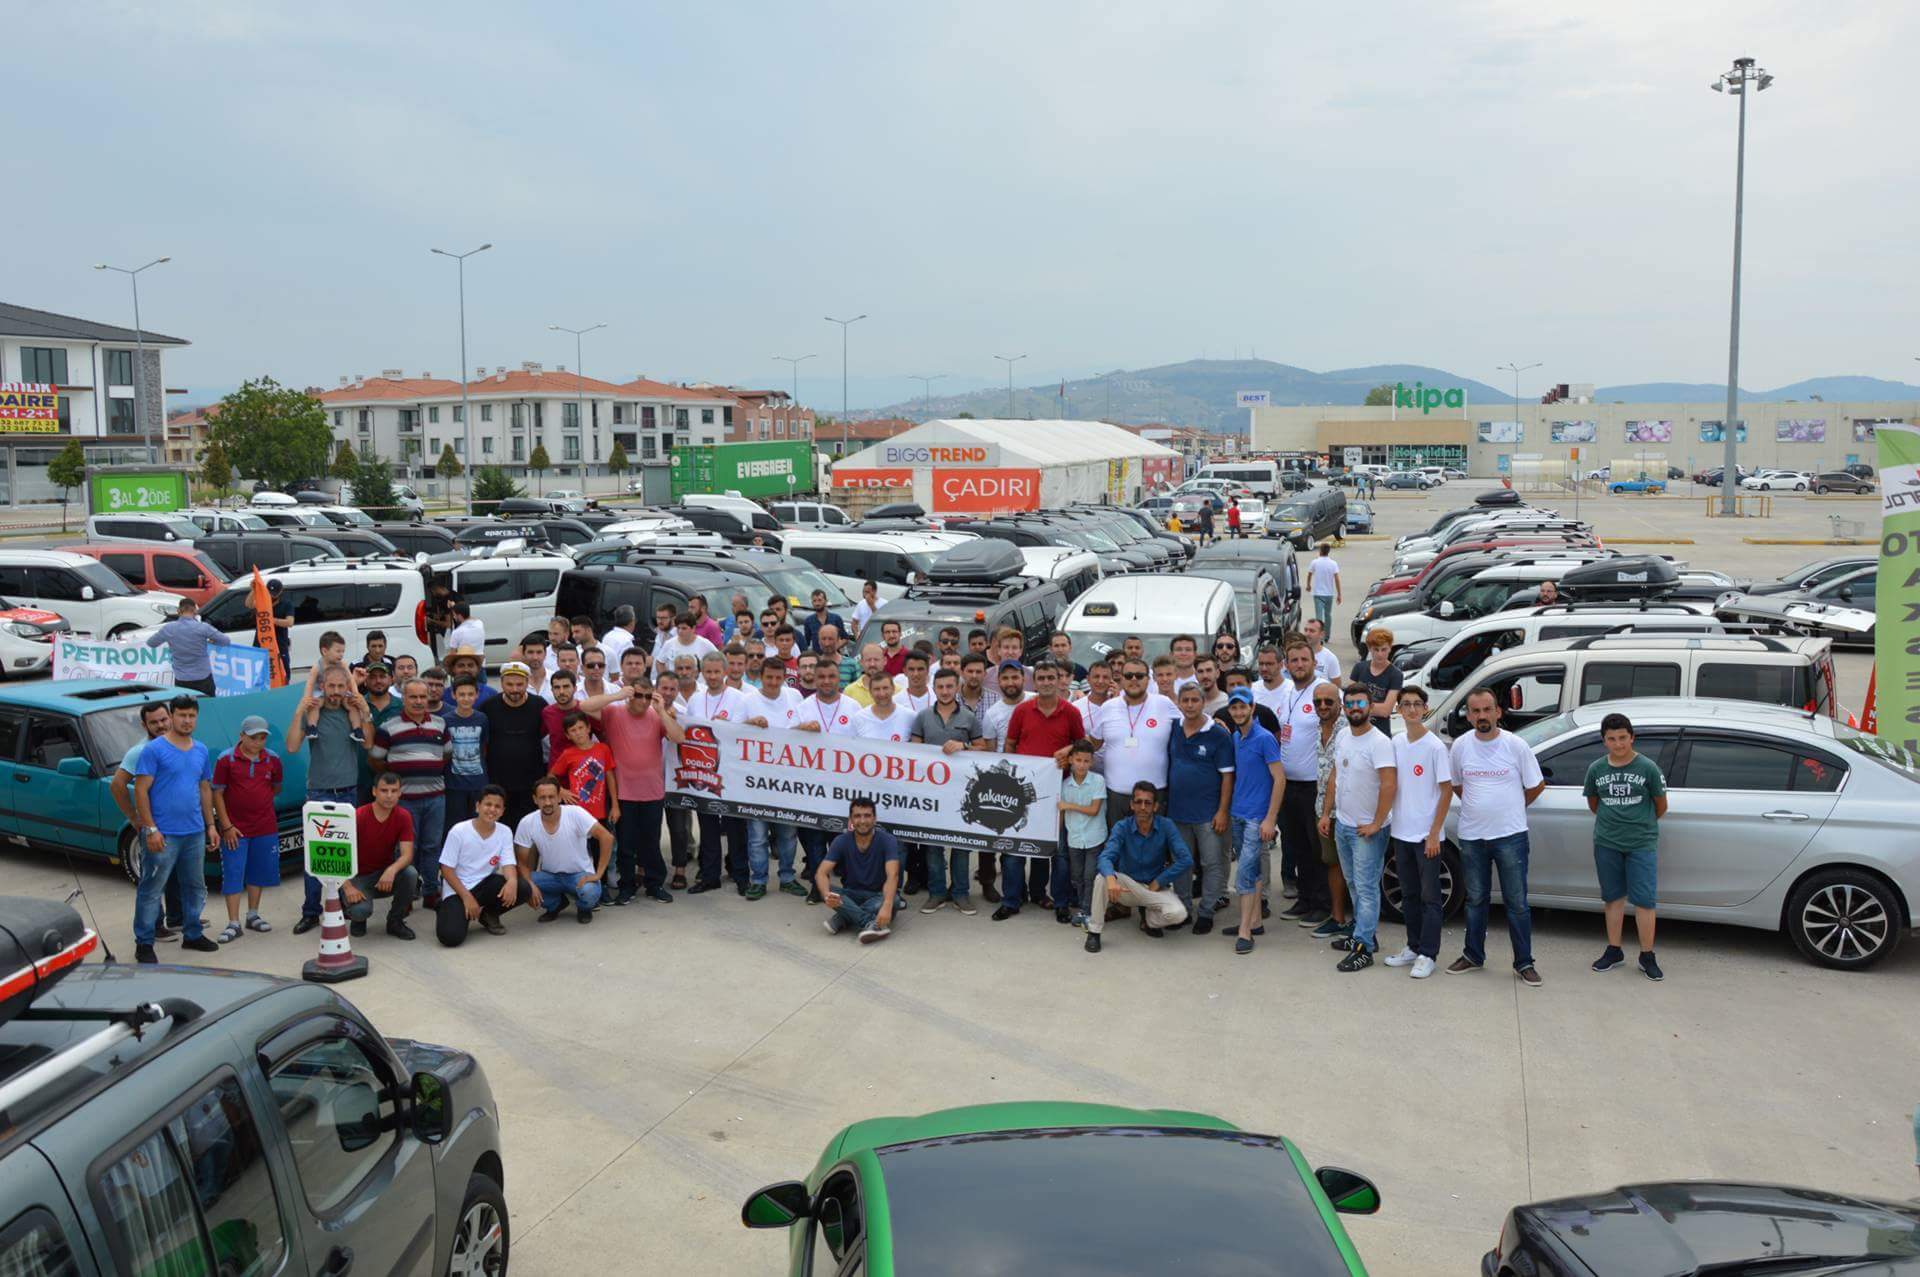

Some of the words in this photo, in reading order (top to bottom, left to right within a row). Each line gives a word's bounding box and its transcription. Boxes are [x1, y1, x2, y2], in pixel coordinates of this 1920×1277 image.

[1396, 382, 1464, 414] kipa
[737, 458, 793, 479] EVERGREEN
[943, 478, 1031, 502] ÇADIRI
[736, 738, 826, 770] TEAM
[832, 749, 951, 786] DOBLO
[1595, 773, 1621, 787] GREAT
[1623, 773, 1646, 786] TEAM
[745, 775, 827, 798] SAKARYA
[833, 787, 939, 812] BULUŞMASI
[978, 789, 1018, 808] sakarya
[893, 829, 988, 847] www.teamdoblo.com
[316, 846, 347, 857] OTO
[311, 859, 352, 875] AKSESUAR
